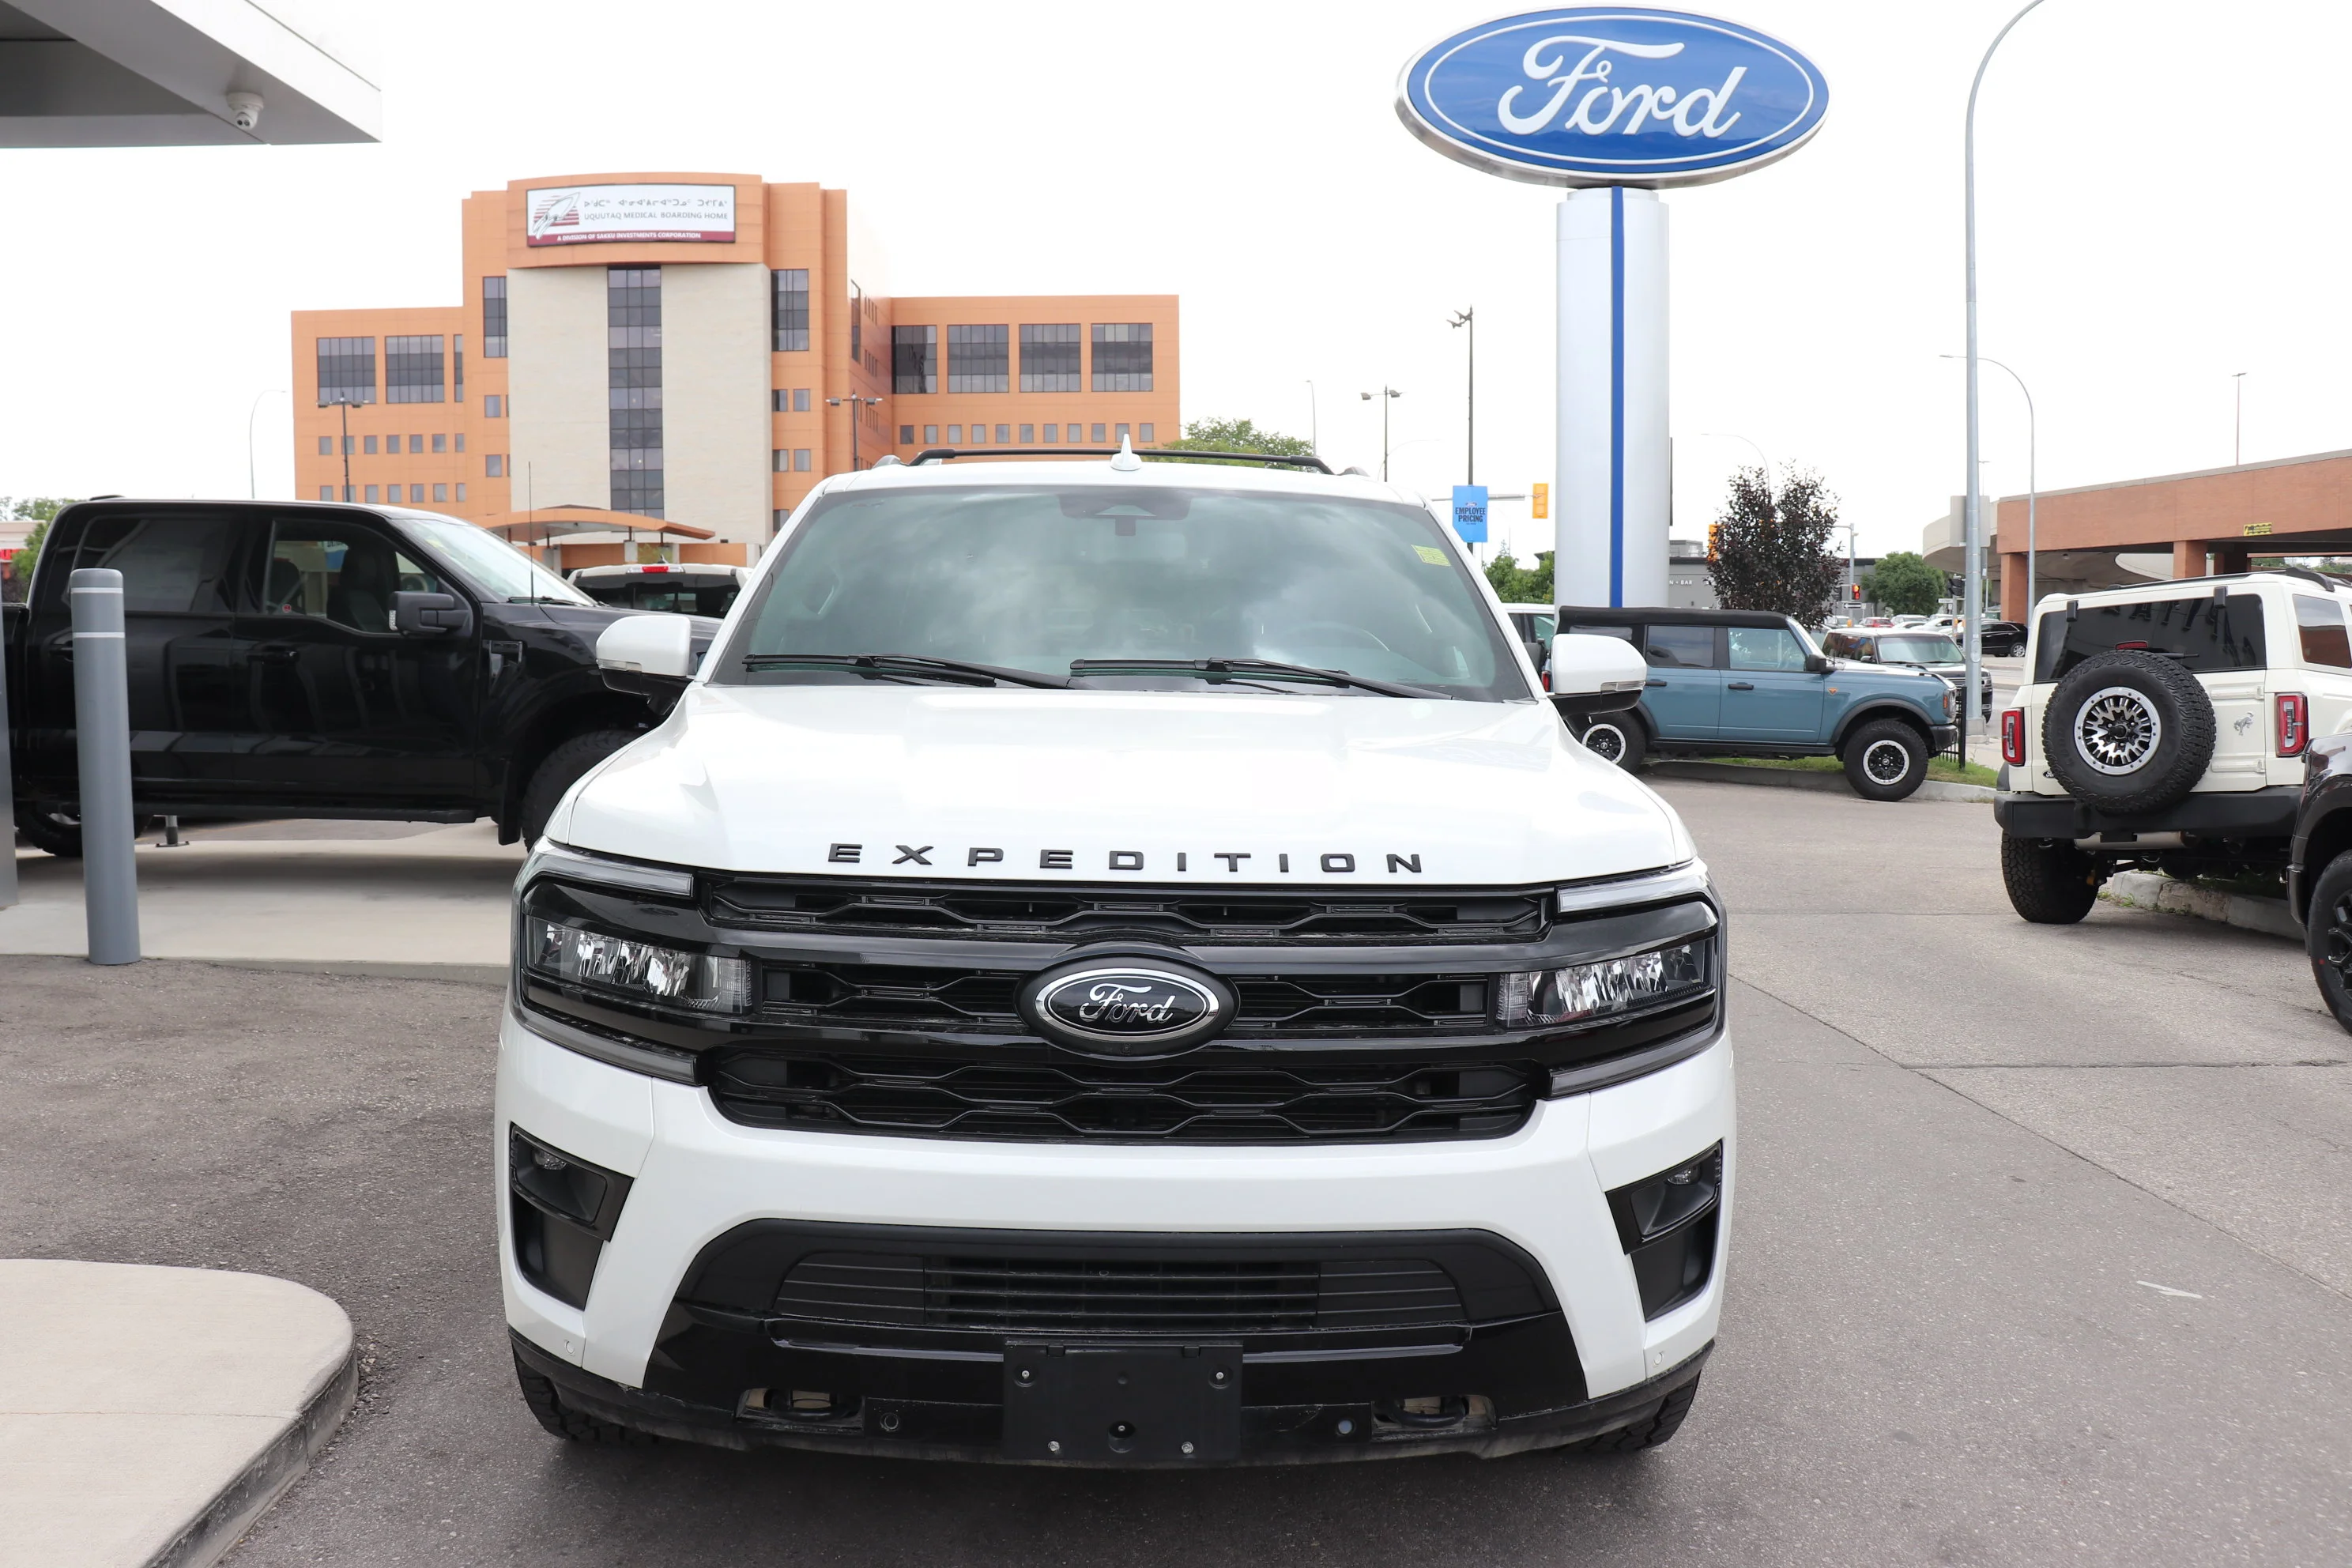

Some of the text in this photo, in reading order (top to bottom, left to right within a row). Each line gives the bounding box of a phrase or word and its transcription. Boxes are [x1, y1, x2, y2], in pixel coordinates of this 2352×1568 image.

[1498, 36, 1747, 138] Ford
[584, 212, 622, 220] UQUUTAQ
[827, 842, 1423, 873] EXPEDITION
[1079, 983, 1176, 1023] Ford
